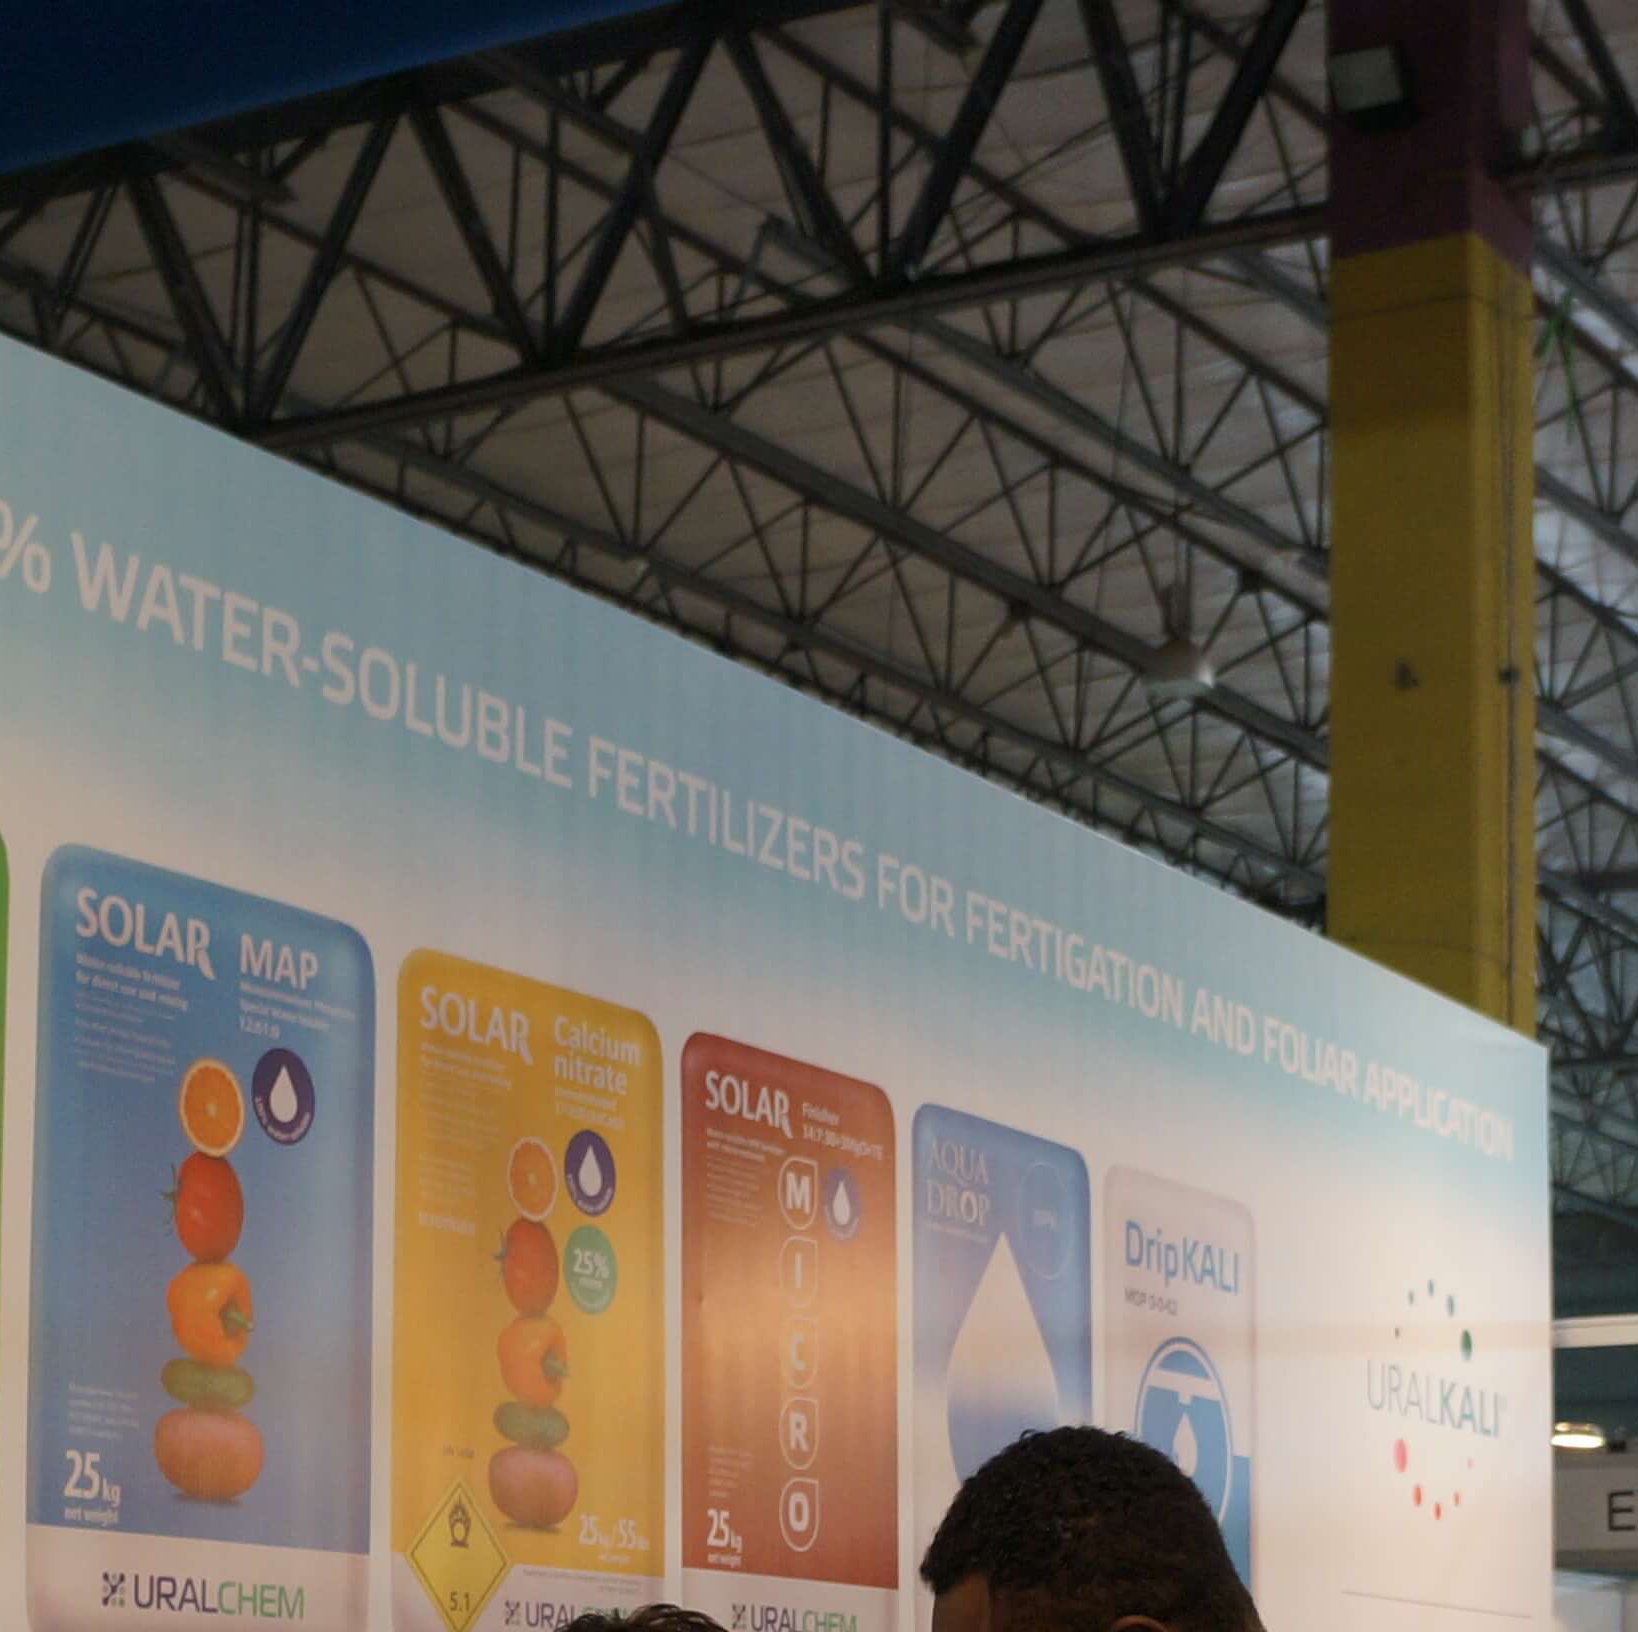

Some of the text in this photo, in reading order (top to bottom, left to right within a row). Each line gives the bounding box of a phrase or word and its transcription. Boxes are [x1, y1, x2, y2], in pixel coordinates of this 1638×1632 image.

[71, 532, 572, 790] WATER-SOLUBLE
[587, 736, 865, 902] FERTILIZERS
[876, 852, 955, 938] FOR
[966, 891, 1183, 1026] FERTIGATION
[1192, 990, 1256, 1059] AND
[1263, 1016, 1359, 1101] FOLIAR
[1363, 1064, 1515, 1163] APPLICATION
[75, 886, 319, 991] SOLAR MAP
[419, 985, 534, 1065] SOLAR
[554, 1014, 642, 1067] Calcium
[554, 1053, 627, 1097] nitrate
[705, 1070, 793, 1139] SOLAR
[573, 1247, 611, 1280] 25%
[1125, 1220, 1240, 1296] DripKALI
[1366, 1359, 1500, 1438] URALKALI
[133, 1574, 304, 1620] URALCHEM
[449, 1591, 471, 1613] 5.1
